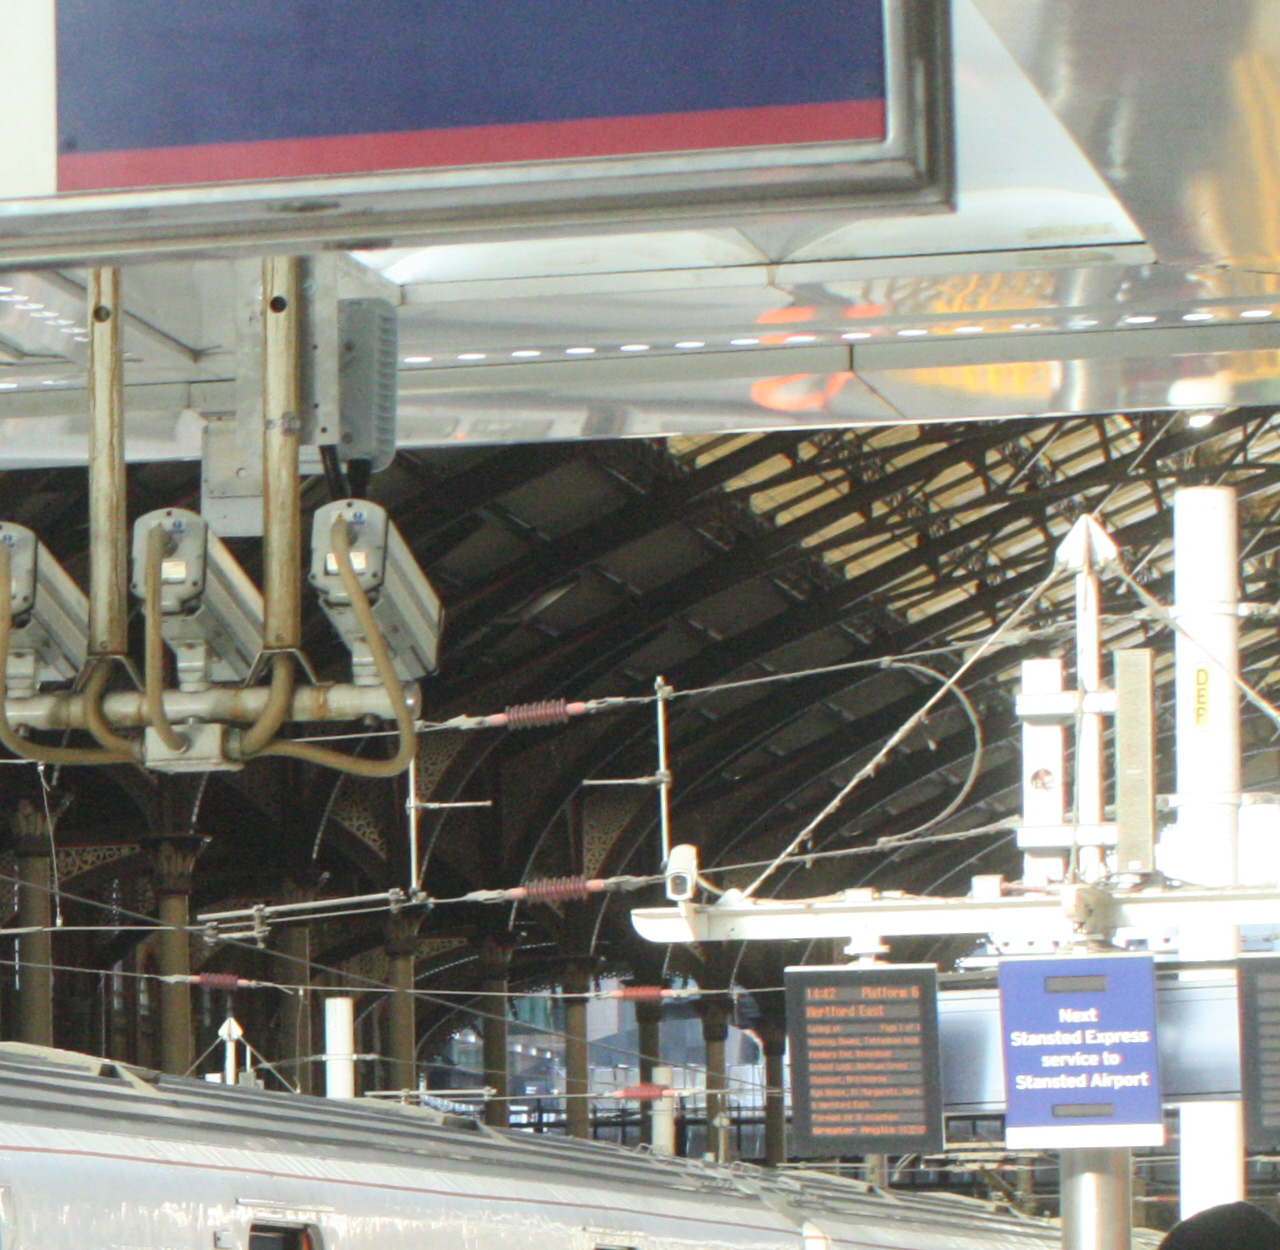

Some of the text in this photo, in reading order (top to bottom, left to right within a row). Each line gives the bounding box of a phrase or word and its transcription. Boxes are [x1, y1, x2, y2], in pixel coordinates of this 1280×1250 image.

[1196, 669, 1209, 723] DEP
[1058, 1008, 1100, 1023] Next
[1010, 1029, 1152, 1046] Stansted Express
[1041, 1050, 1122, 1067] service to
[1015, 1071, 1151, 1090] Stansted Airport
